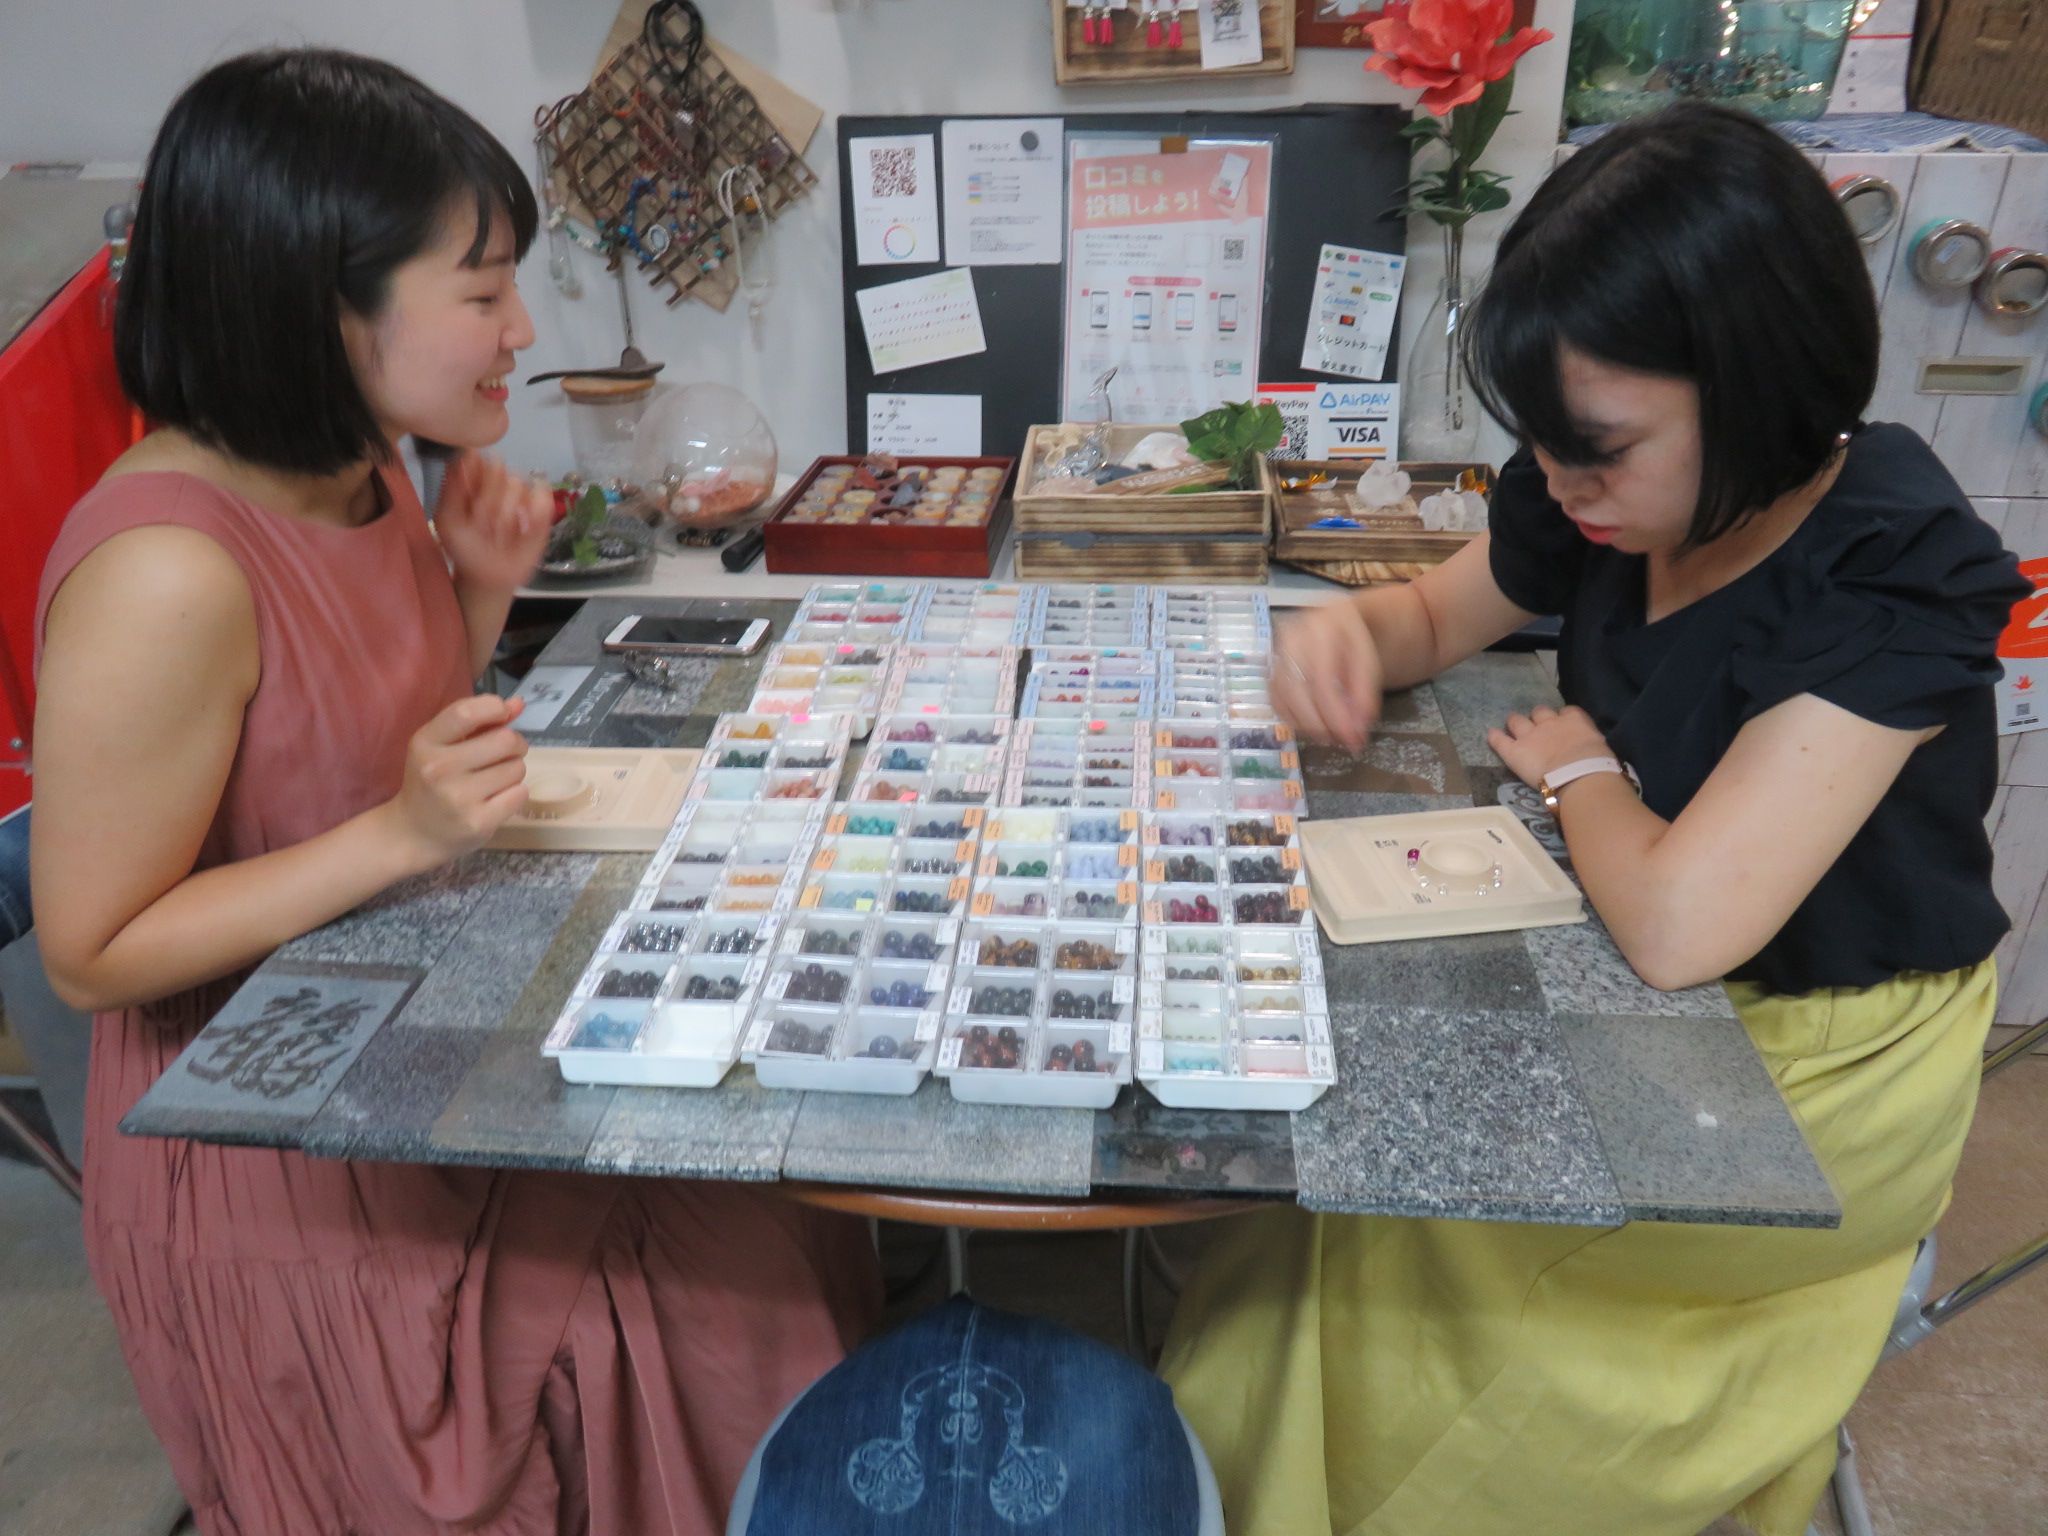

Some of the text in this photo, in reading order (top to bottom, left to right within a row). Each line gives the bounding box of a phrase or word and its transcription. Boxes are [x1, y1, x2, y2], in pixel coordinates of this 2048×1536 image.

[1084, 164, 1165, 190] 口コミを
[1337, 427, 1381, 442] VISA
